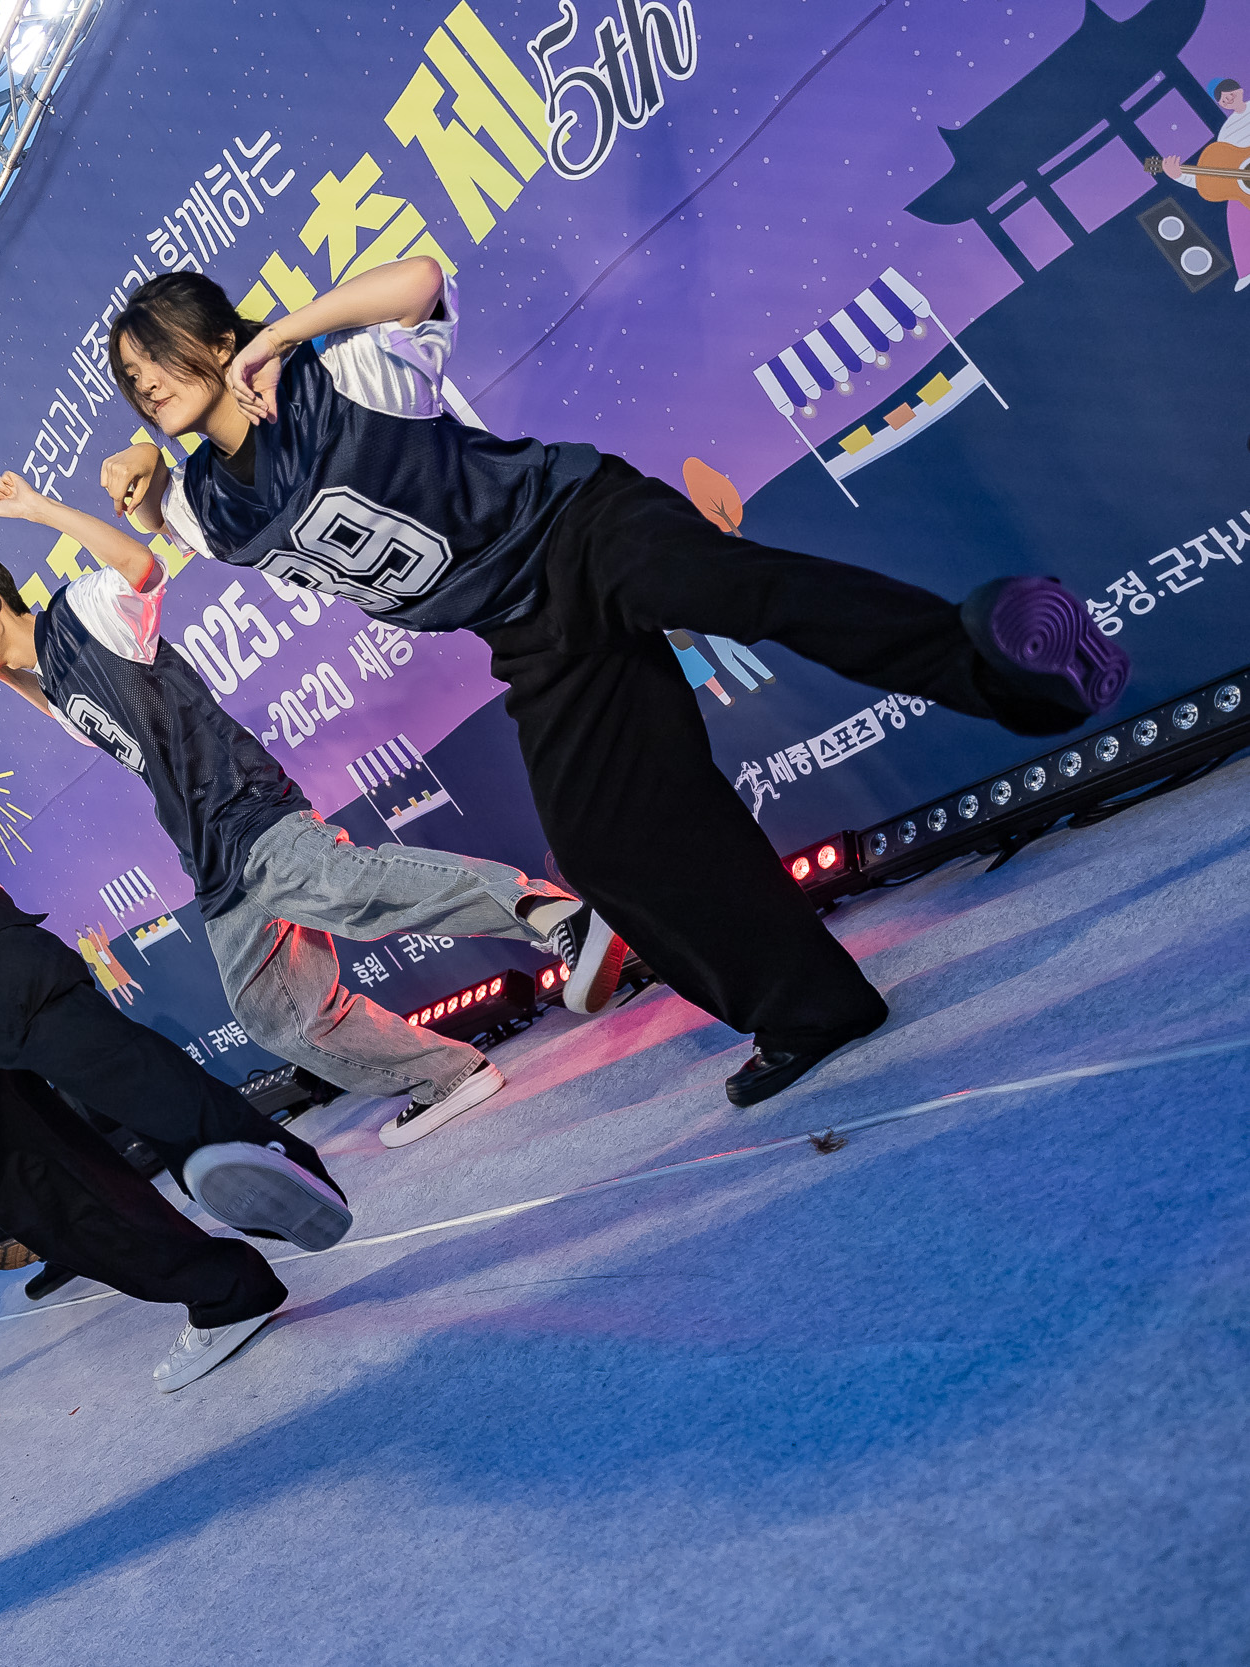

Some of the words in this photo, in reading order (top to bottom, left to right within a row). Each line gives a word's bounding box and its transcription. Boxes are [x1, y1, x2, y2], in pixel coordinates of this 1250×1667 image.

[526, 0, 698, 181] 5th
[146, 130, 296, 274] 함께하는
[66, 693, 146, 773] 3
[244, 662, 355, 750] ~20:20
[347, 617, 445, 682] 세종
[352, 952, 390, 988] 후원
[181, 1041, 206, 1066] 관
[207, 1020, 249, 1053] 군자동
